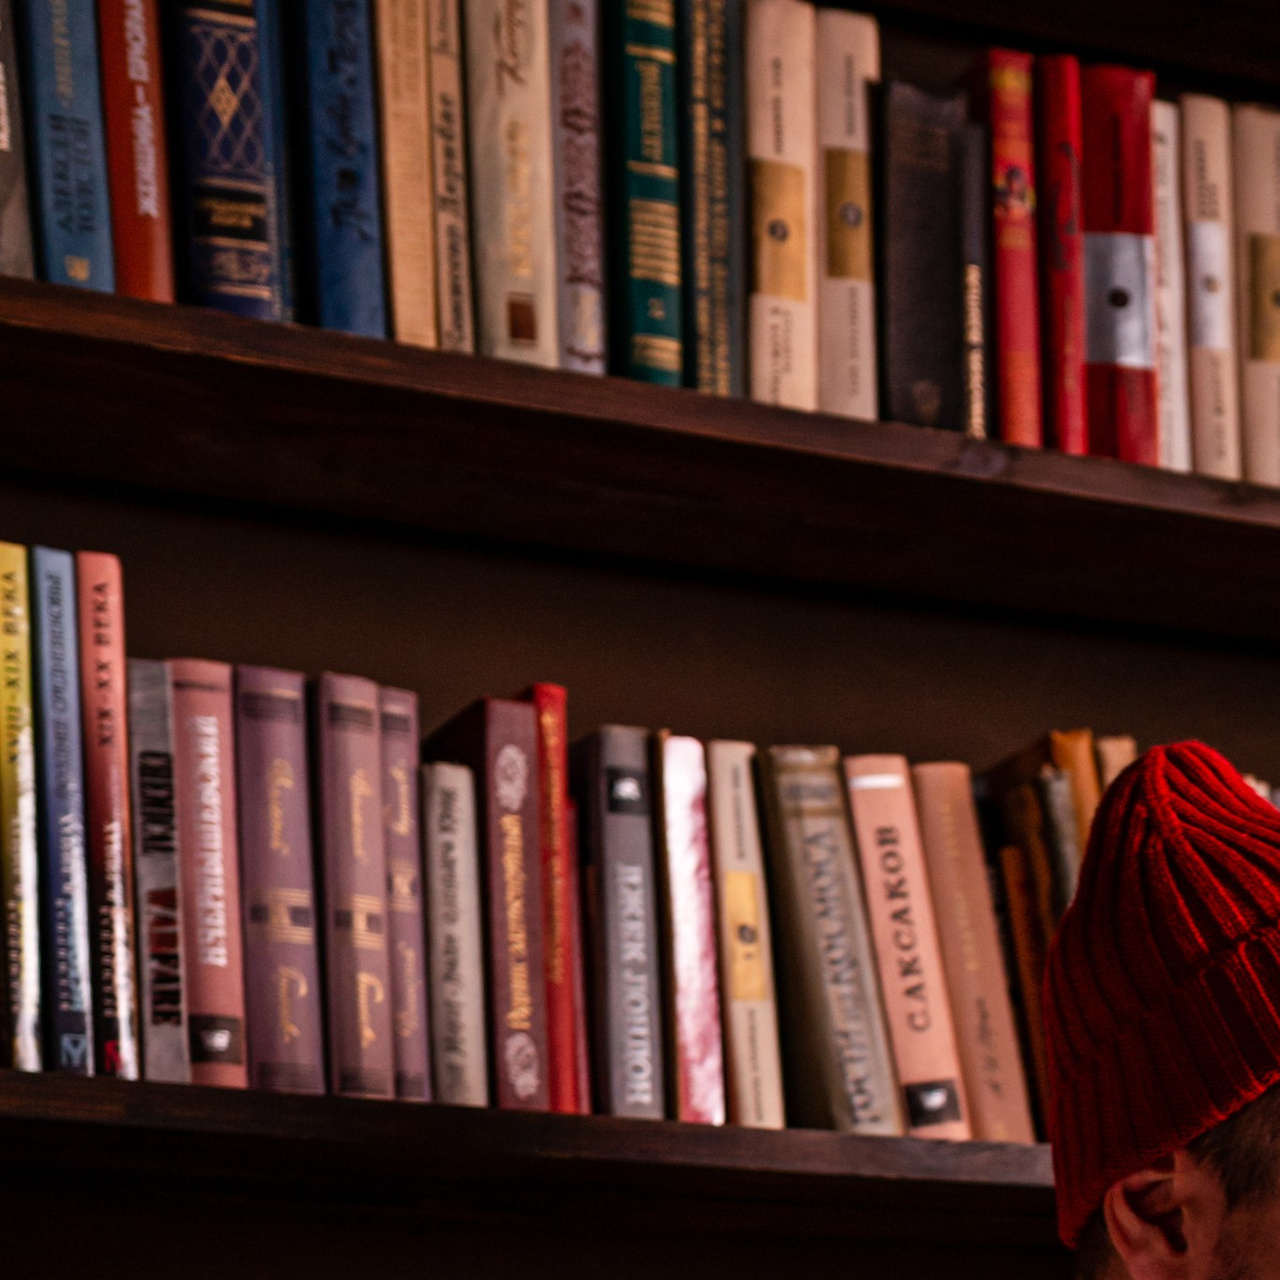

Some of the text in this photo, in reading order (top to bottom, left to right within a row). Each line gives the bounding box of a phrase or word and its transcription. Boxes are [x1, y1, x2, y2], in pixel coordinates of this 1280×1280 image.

[47, 114, 76, 243] АЛЕКСЕЙ
[68, 116, 96, 241] ТОЛСТОЙ
[2, 571, 18, 636] ВЕКА
[45, 570, 69, 717] СРЕДНЕВЕКОВЬЕ
[92, 581, 111, 647] ВЕКА
[140, 751, 183, 1027] CHEMICAL WARFARE
[801, 832, 860, 985] КОСМОСА
[874, 826, 934, 1034] С.АКСАКОВ
[55, 897, 73, 1013] ВСЕМИРНАЯ
[98, 904, 117, 1020] ВСЕМИРНАЯ
[617, 862, 653, 1107] ДЖЕК ЛОНДОН
